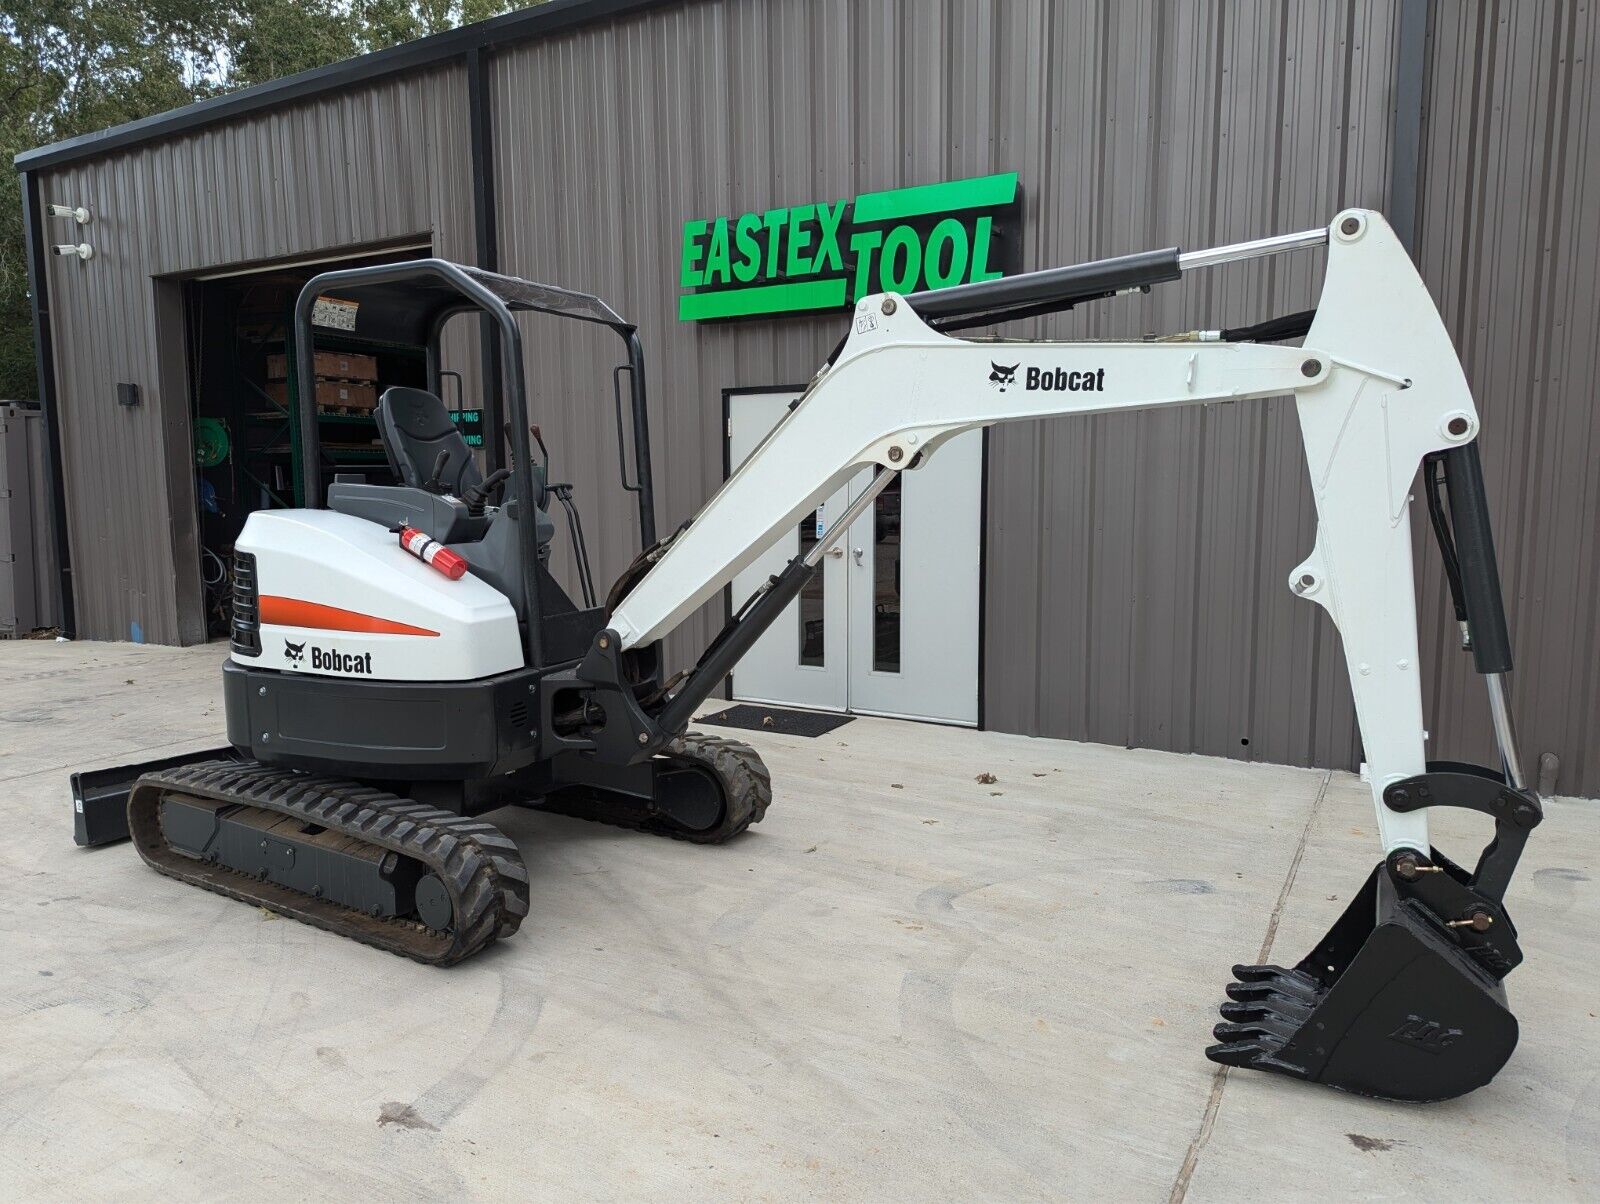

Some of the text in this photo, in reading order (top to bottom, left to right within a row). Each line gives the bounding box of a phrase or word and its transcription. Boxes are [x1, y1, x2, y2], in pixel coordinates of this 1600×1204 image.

[680, 199, 1004, 305] EASTEX TOOL
[1026, 366, 1105, 392] Bobcat
[311, 646, 372, 675] Bobcat
